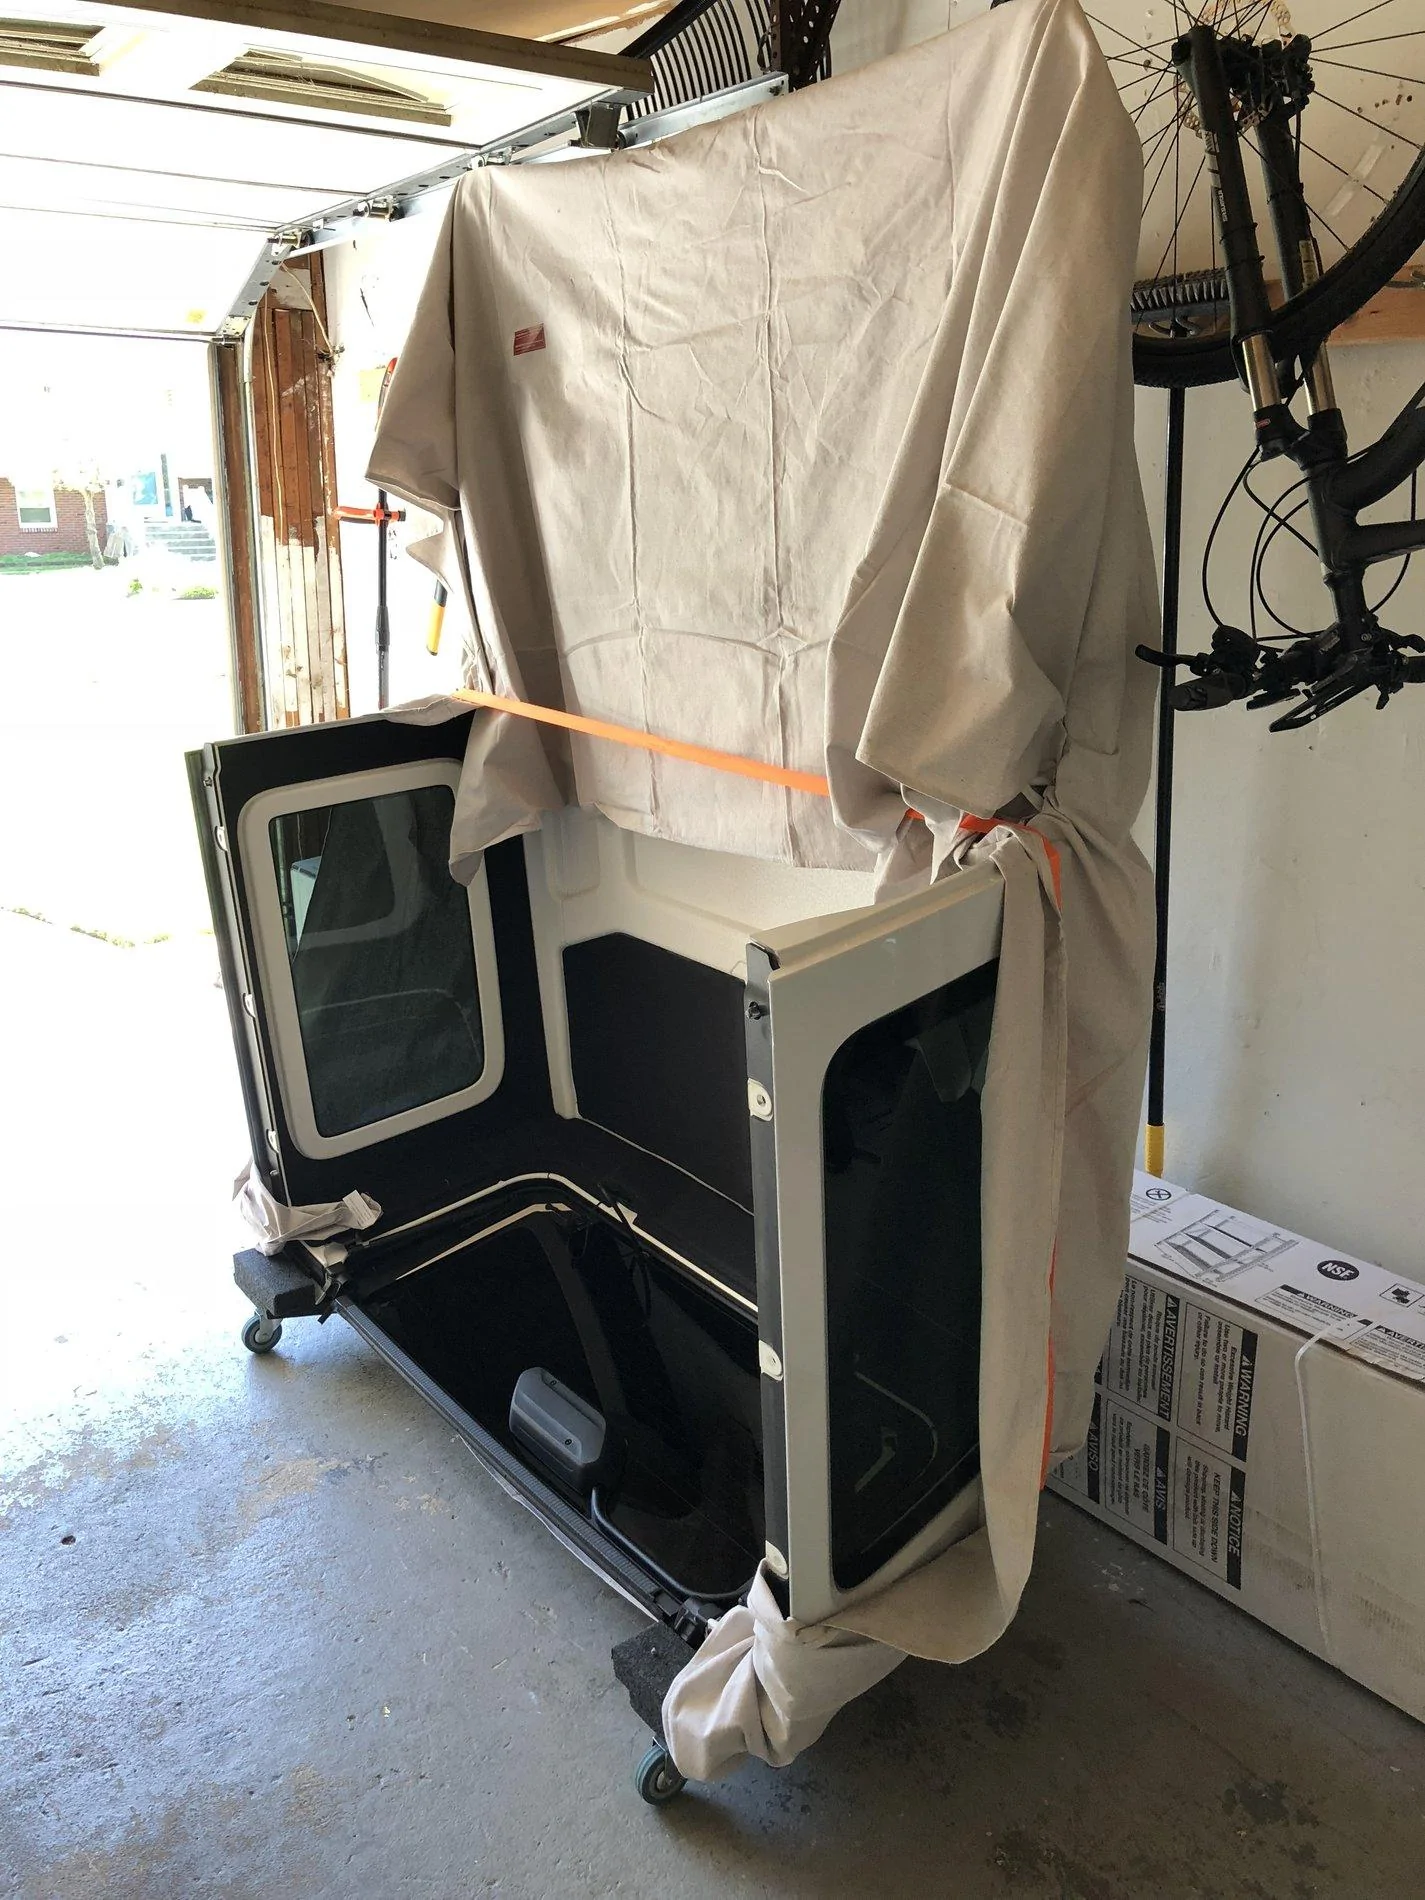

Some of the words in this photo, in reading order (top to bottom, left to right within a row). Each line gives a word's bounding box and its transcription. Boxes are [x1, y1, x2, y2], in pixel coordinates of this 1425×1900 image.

[1321, 1262, 1355, 1278] NSF
[1305, 1294, 1355, 1319] WARNING
[1203, 1315, 1211, 1340] Failure
[1215, 1321, 1223, 1355] assemble
[1157, 1308, 1178, 1419] AVERTISSEMENT
[1228, 1346, 1237, 1382] Excessive
[1197, 1381, 1205, 1402] result
[1216, 1380, 1225, 1405] people
[1225, 1381, 1234, 1406] Weight
[1235, 1366, 1252, 1438] WARNING
[1195, 1408, 1203, 1427] back
[1223, 1405, 1232, 1431] Hazard
[1088, 1429, 1099, 1471] AVISO
[1155, 1478, 1166, 1512] AVIS
[1213, 1472, 1221, 1497] KEEP
[1212, 1496, 1220, 1518] THIS
[1211, 1515, 1219, 1538] SIDE
[1228, 1503, 1242, 1558] NOTICE
[1210, 1536, 1218, 1564] DOWN
